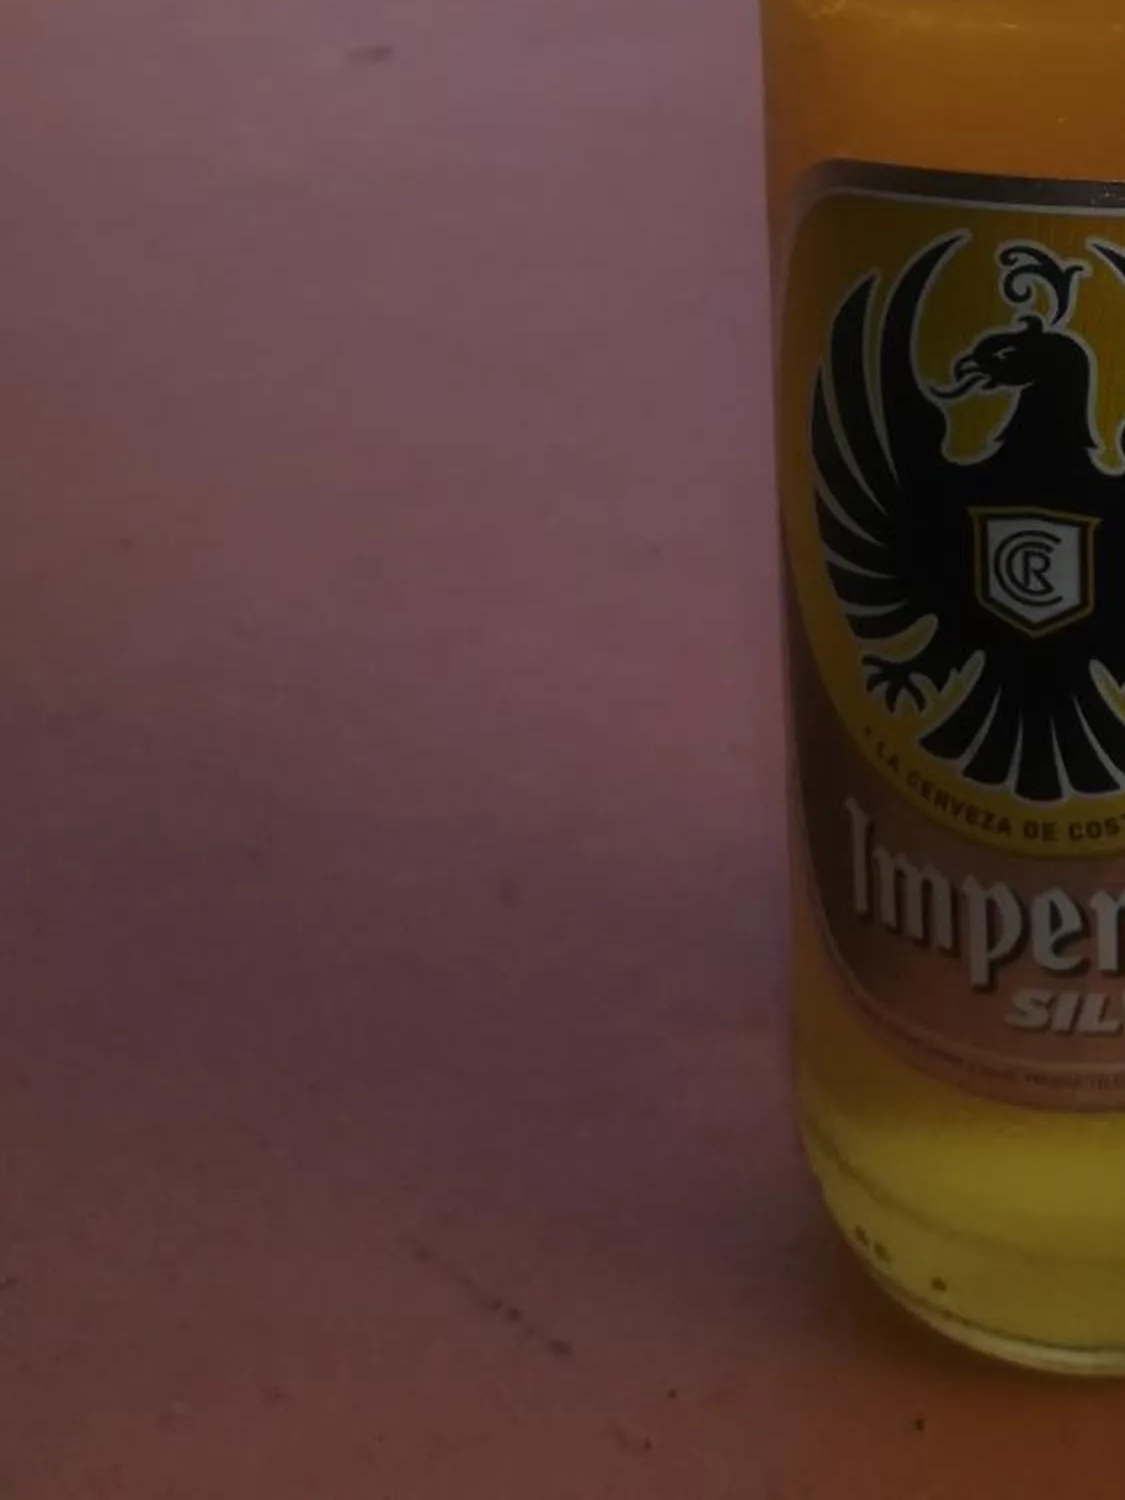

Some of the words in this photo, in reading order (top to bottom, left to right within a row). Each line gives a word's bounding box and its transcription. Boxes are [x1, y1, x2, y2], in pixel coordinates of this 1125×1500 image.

[876, 739, 900, 775] LA
[905, 769, 1011, 839] CERVEZA
[1022, 820, 1059, 843] DE
